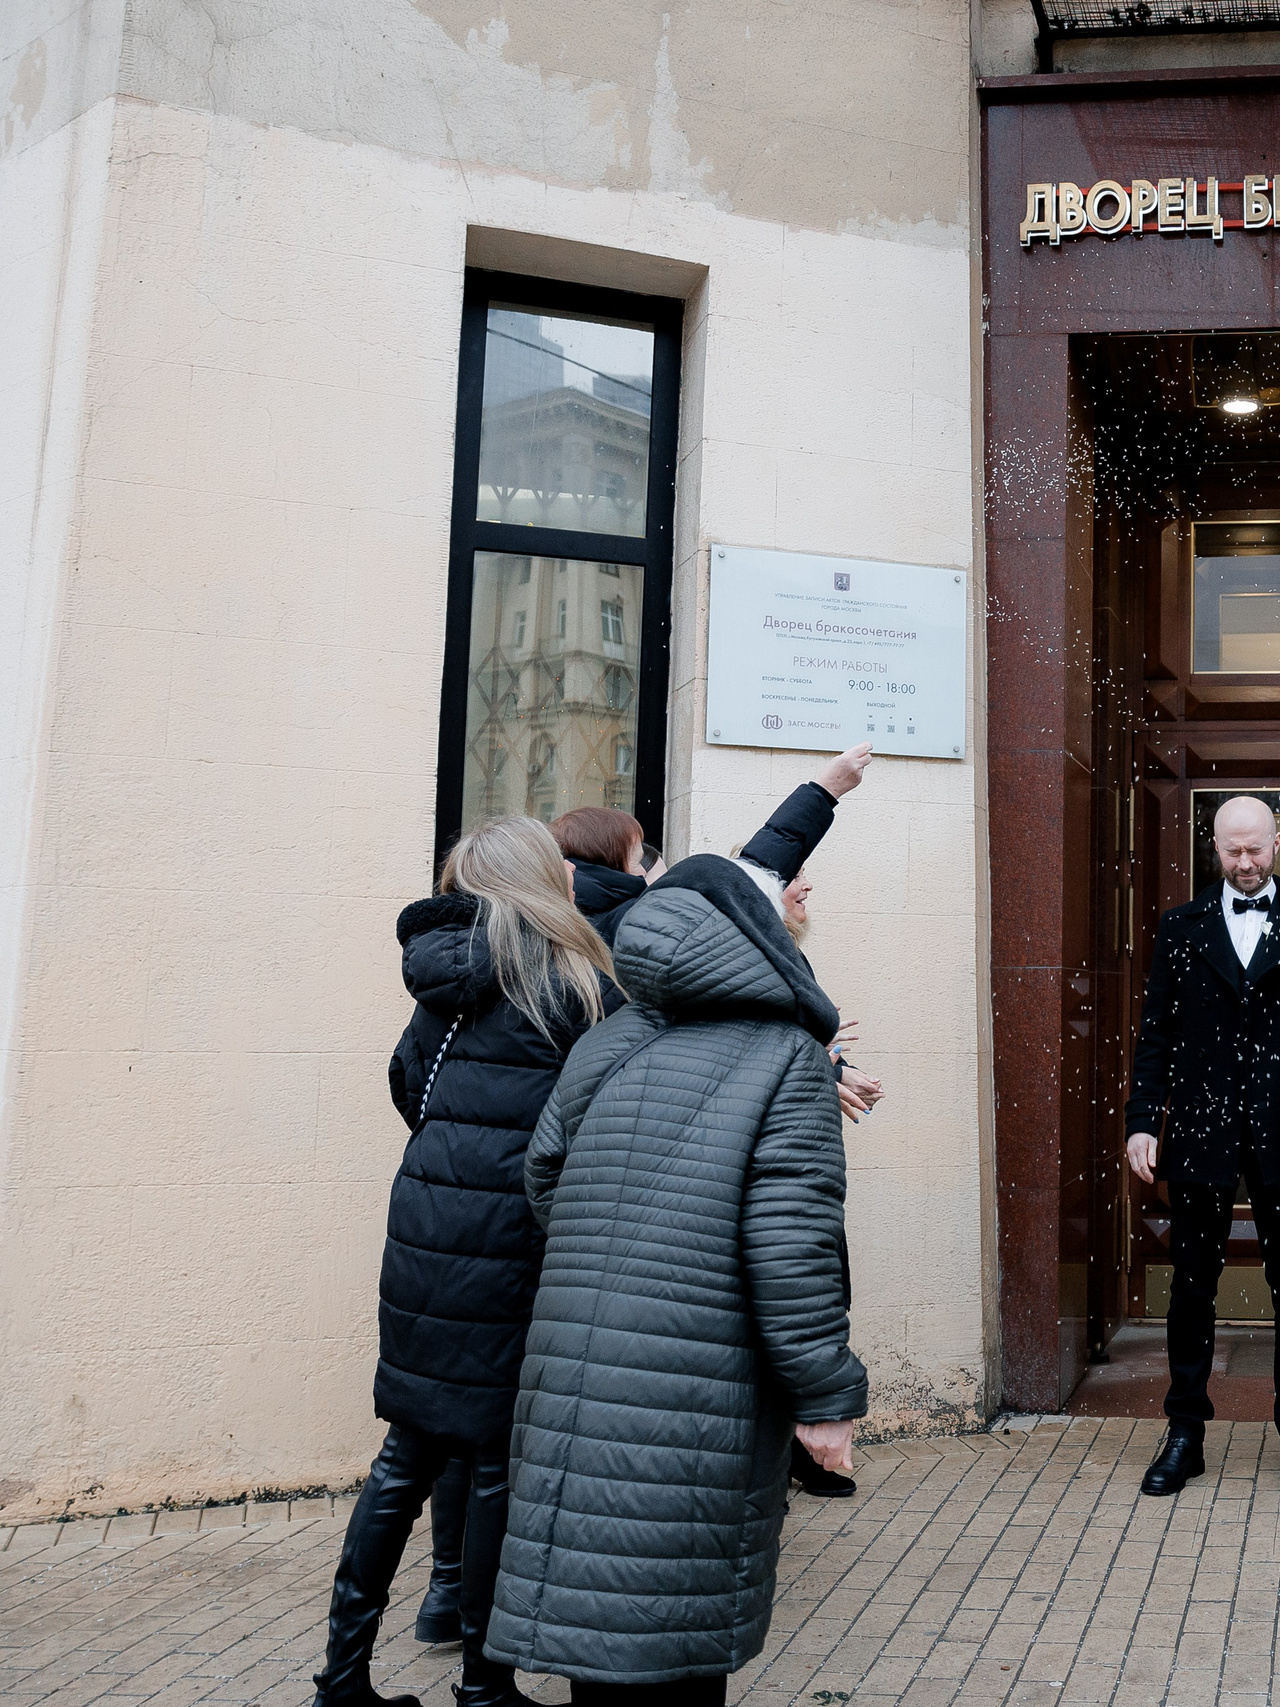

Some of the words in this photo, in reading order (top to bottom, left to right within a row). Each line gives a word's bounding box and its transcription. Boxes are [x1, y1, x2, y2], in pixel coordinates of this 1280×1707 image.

[1020, 177, 1223, 246] ДВОРЕЦ
[774, 592, 804, 601] УПРАВЛЕНИЕ
[842, 599, 879, 607] ГРАЖДАНСКОГО
[763, 615, 813, 633] Дворец
[815, 619, 917, 640] бракосочетания
[793, 656, 838, 669] РЕЖИМ
[841, 659, 888, 674] РАБОТЫ
[761, 675, 786, 683] ВТОРНИК
[789, 677, 813, 685] СУББОТА
[848, 679, 874, 692] 9:00
[886, 682, 916, 695] 18:00
[800, 696, 839, 704] ПОНЕДЕЛЬНИК
[787, 719, 806, 728] ЗАГС
[806, 721, 841, 730] МОСКВЫ
